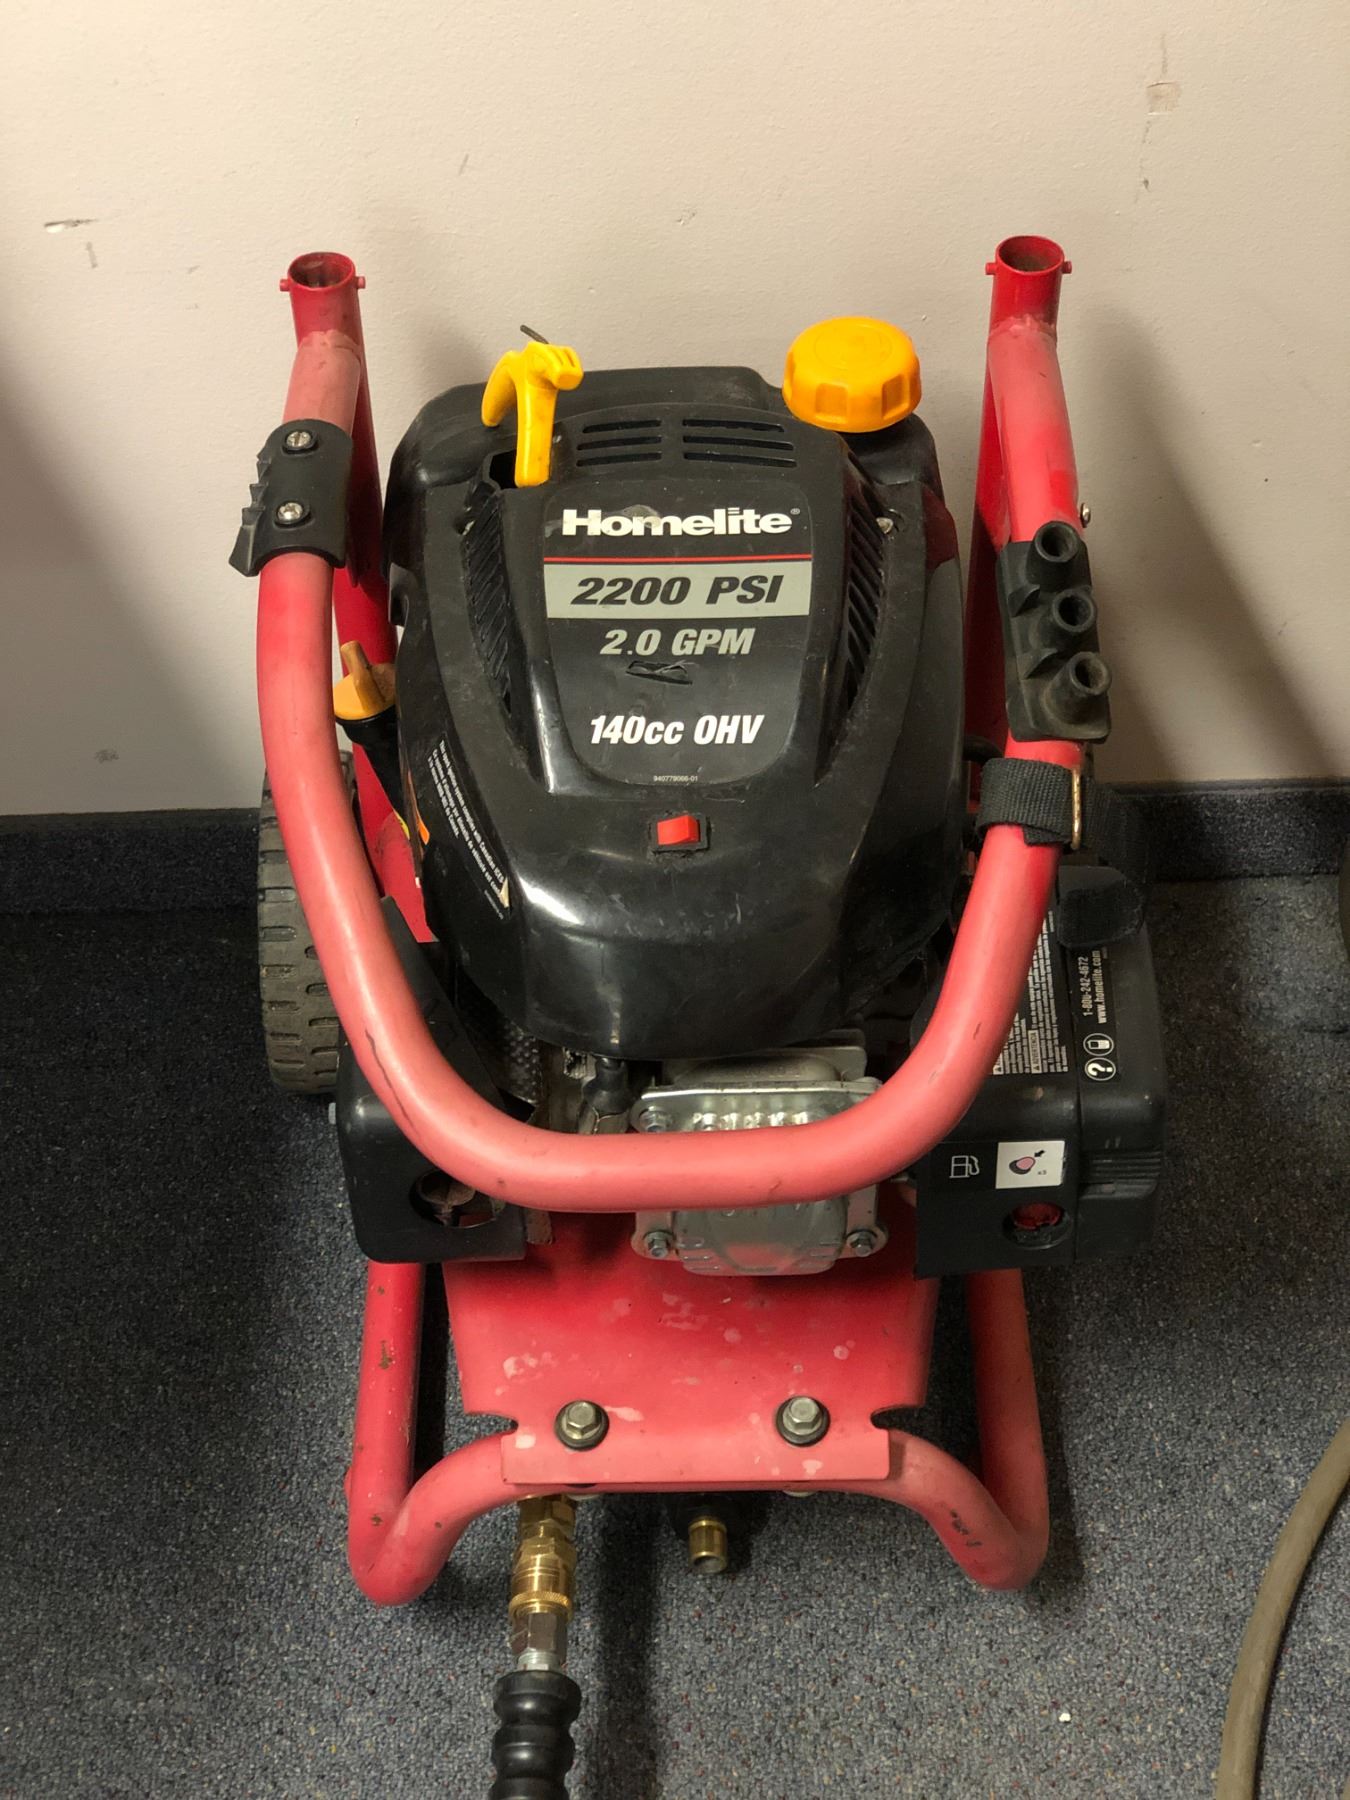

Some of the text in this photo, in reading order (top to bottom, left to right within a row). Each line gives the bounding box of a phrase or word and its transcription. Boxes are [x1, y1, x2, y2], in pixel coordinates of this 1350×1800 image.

[562, 508, 792, 537] Homelite
[571, 575, 784, 606] 2200 PSI
[600, 628, 756, 656] 2.0 GPM
[590, 715, 765, 745] 140cc OHV
[480, 842, 495, 869] Canadian
[1092, 950, 1107, 1024] www.homelite.com
